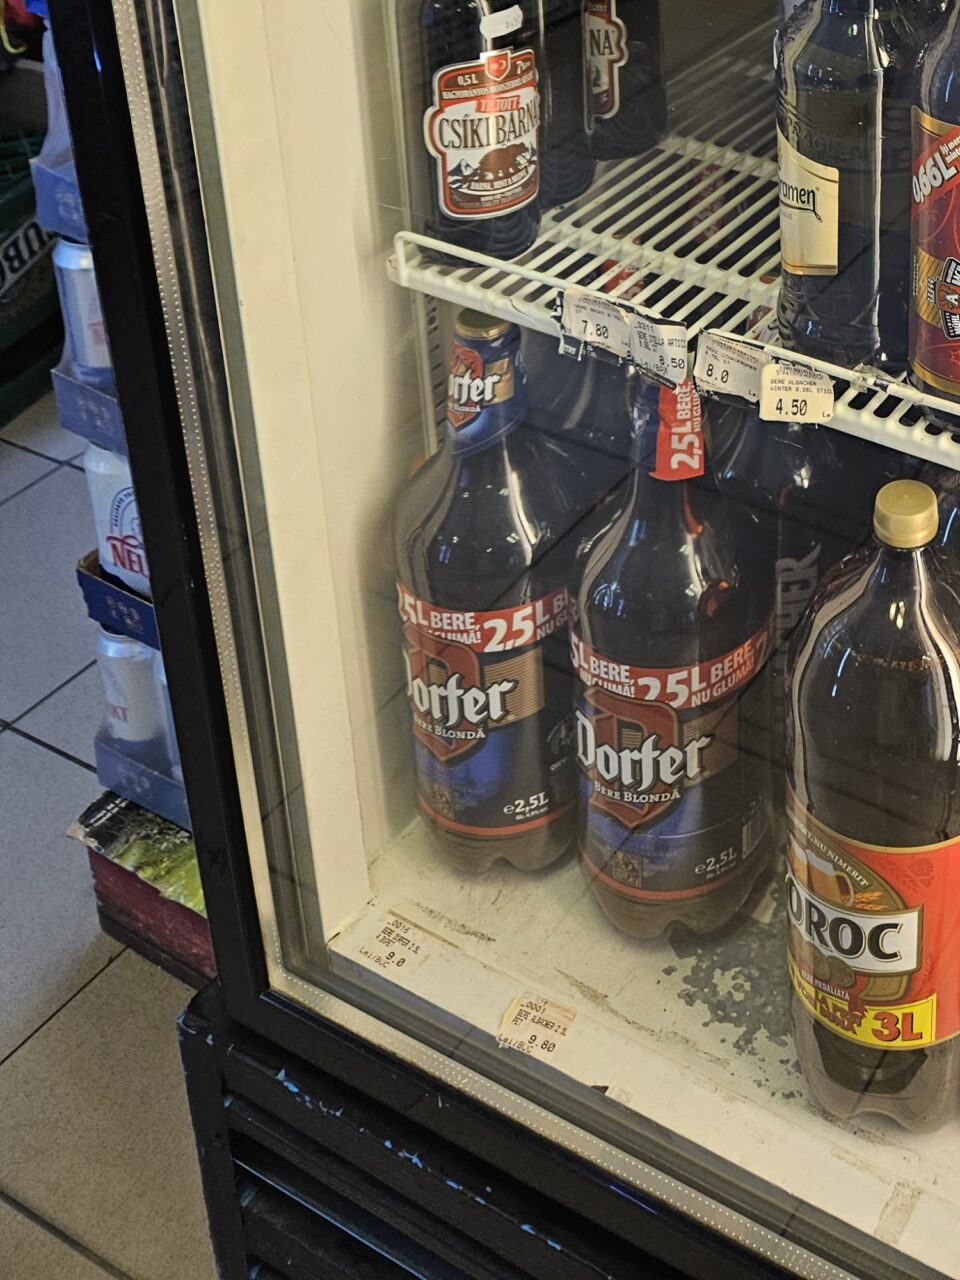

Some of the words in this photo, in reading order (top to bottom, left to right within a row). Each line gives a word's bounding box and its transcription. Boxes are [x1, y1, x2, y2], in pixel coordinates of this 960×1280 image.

[438, 114, 493, 149] CSÍKI
[911, 152, 958, 205] 0,66L
[581, 319, 609, 339] 7.80
[658, 355, 685, 370] 8.50
[706, 363, 729, 384] 8.0
[775, 398, 808, 417] 4.50
[430, 612, 480, 632] BERE,
[483, 600, 550, 653] 2,5L
[589, 655, 632, 683] BERE,
[711, 646, 753, 683] BERE
[692, 691, 710, 707] NU
[434, 725, 486, 740] BLONDĂ
[575, 708, 712, 792] Dorfer
[624, 787, 681, 804] BLONDĂ
[827, 849, 869, 887] NIMERIT
[787, 877, 904, 962] OROC
[386, 951, 406, 967] 9.0
[871, 1011, 923, 1042] 3L
[527, 1034, 557, 1053] 9.80
